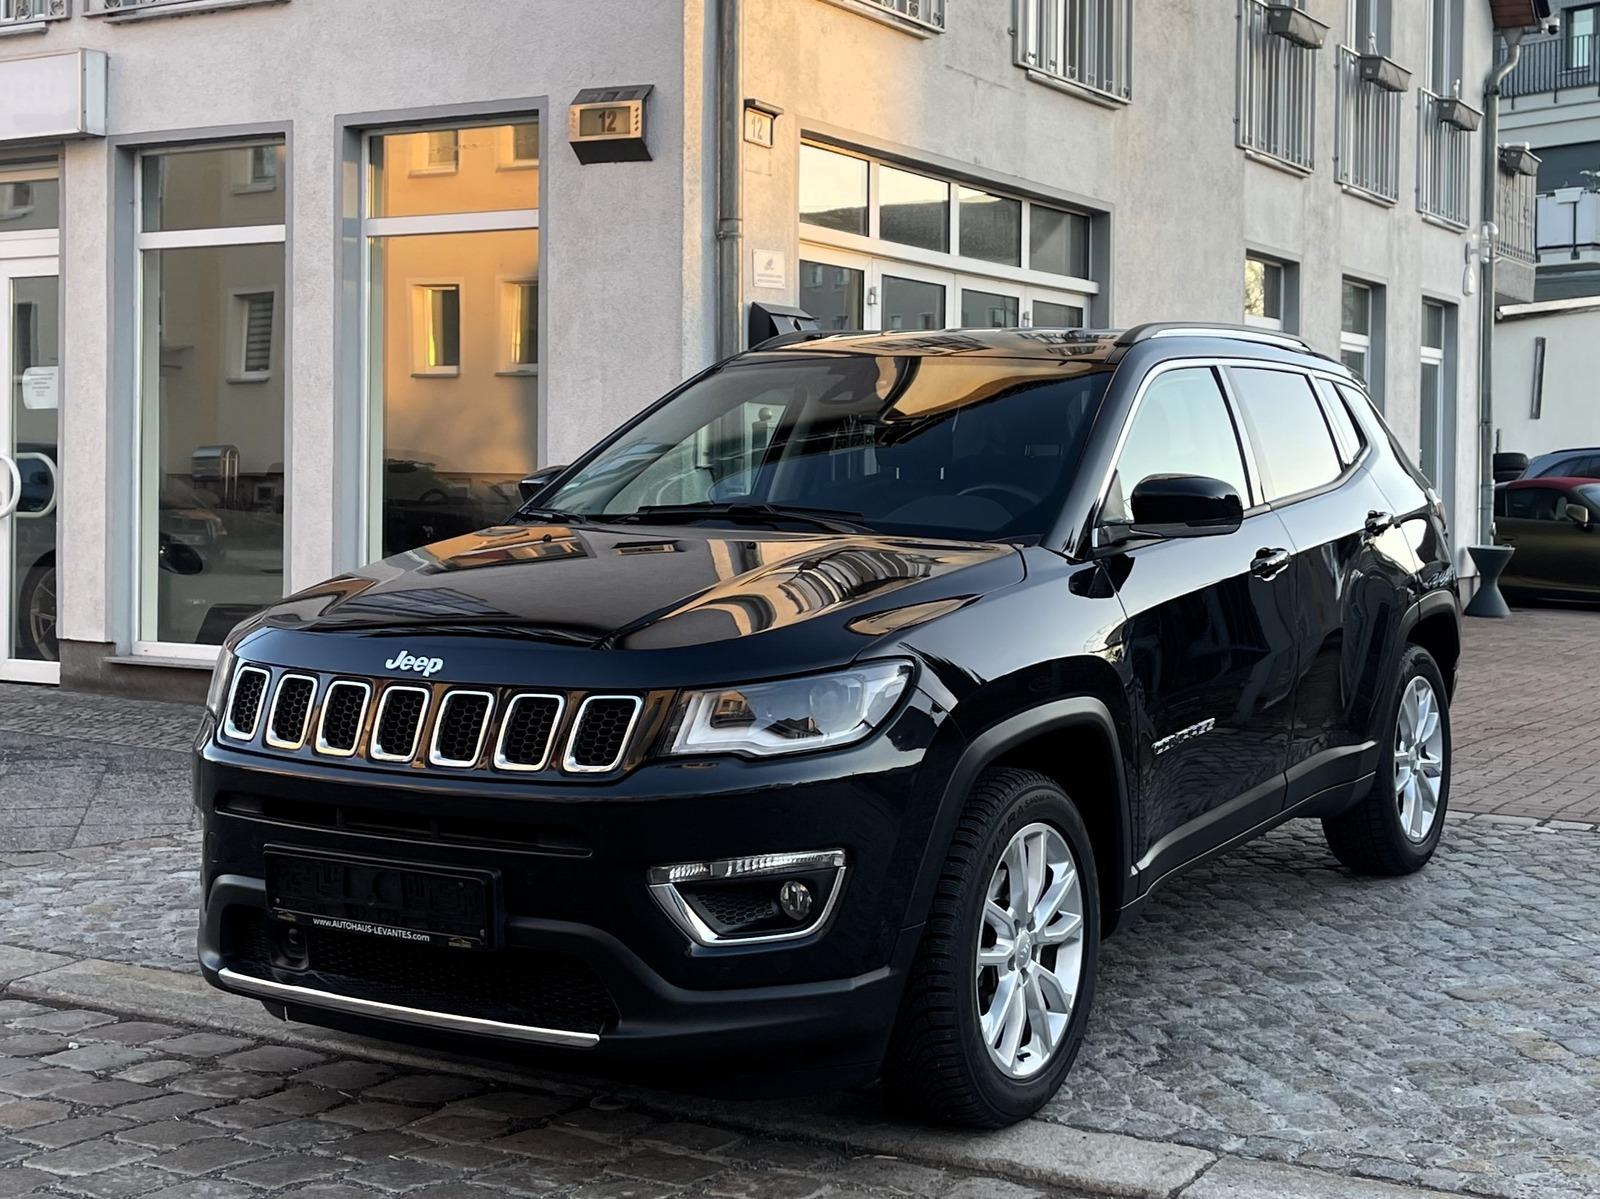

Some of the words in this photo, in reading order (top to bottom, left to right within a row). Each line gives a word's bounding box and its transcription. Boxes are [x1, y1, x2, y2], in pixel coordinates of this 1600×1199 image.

[598, 110, 616, 133] 12
[751, 117, 763, 140] 12
[385, 650, 444, 677] Jeep
[312, 917, 430, 942] www.AUTOHAUS-LEVANTES.com
